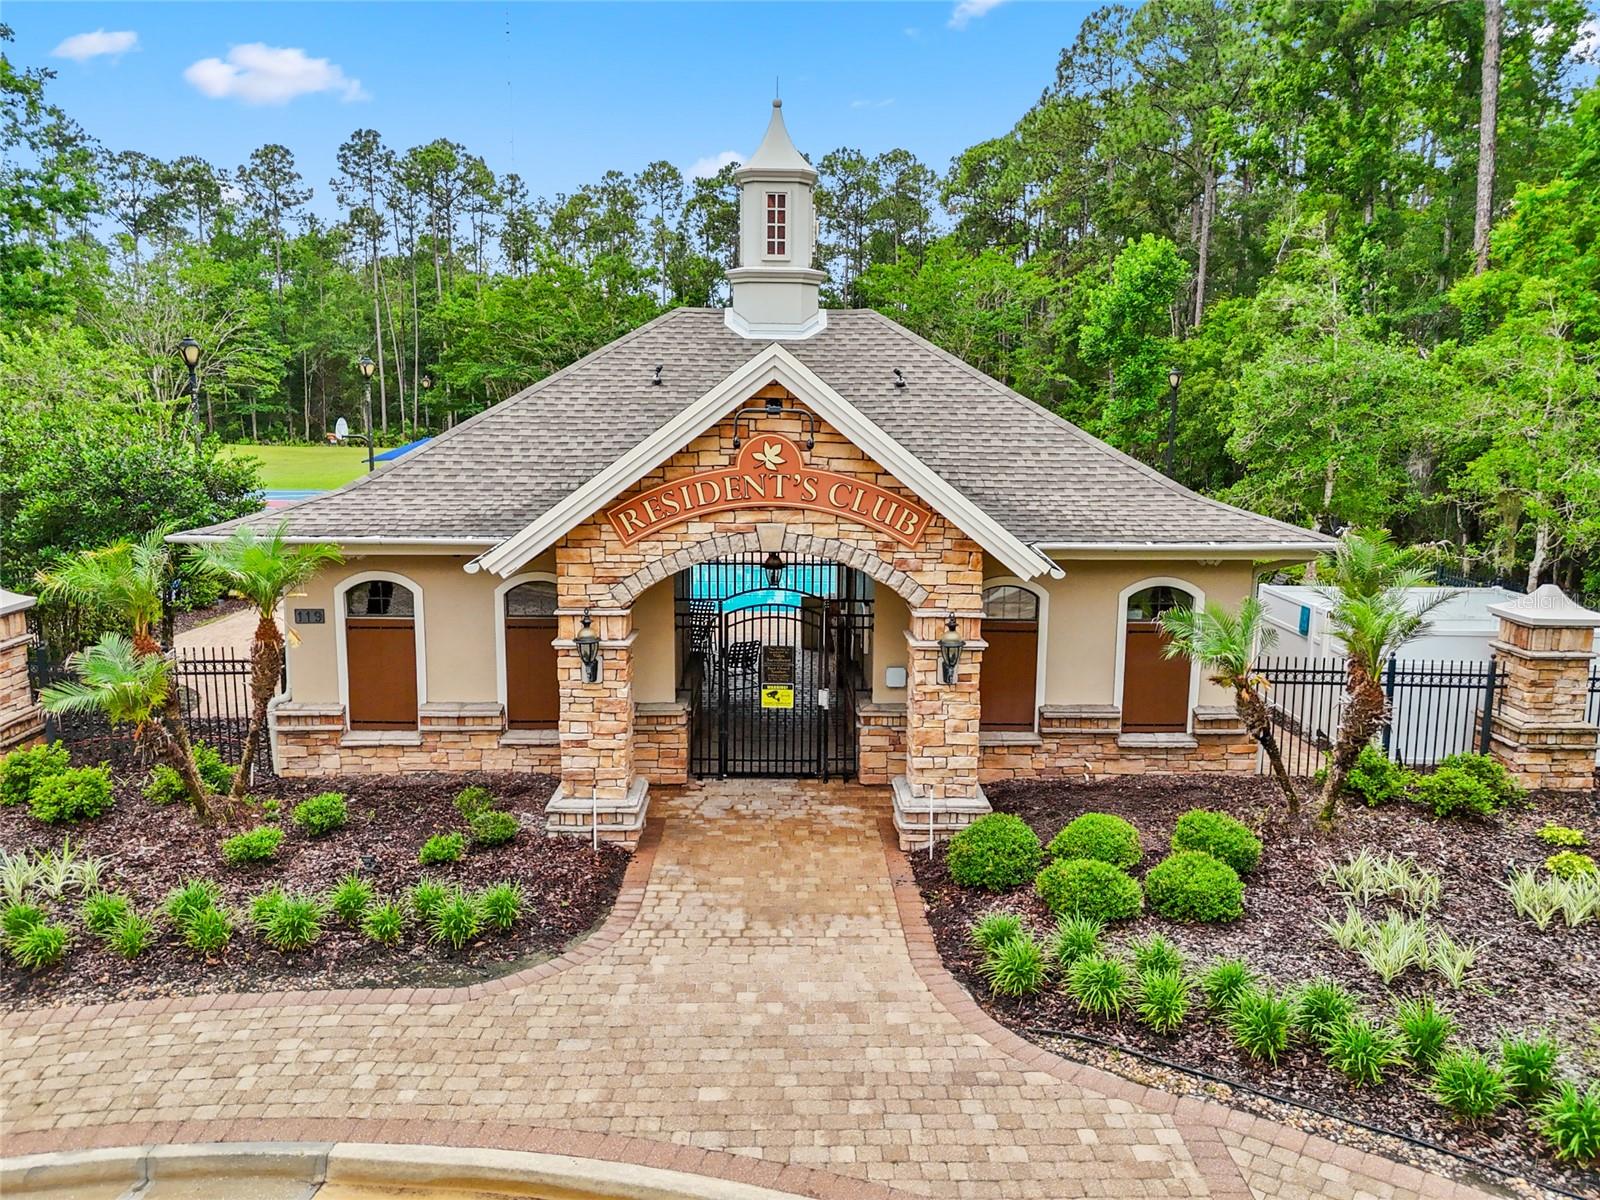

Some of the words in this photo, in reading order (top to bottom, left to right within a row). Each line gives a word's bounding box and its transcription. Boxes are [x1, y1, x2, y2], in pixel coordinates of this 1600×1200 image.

[617, 473, 819, 536] RESIDENT'S
[828, 482, 921, 537] CLUB
[297, 611, 323, 623] 119
